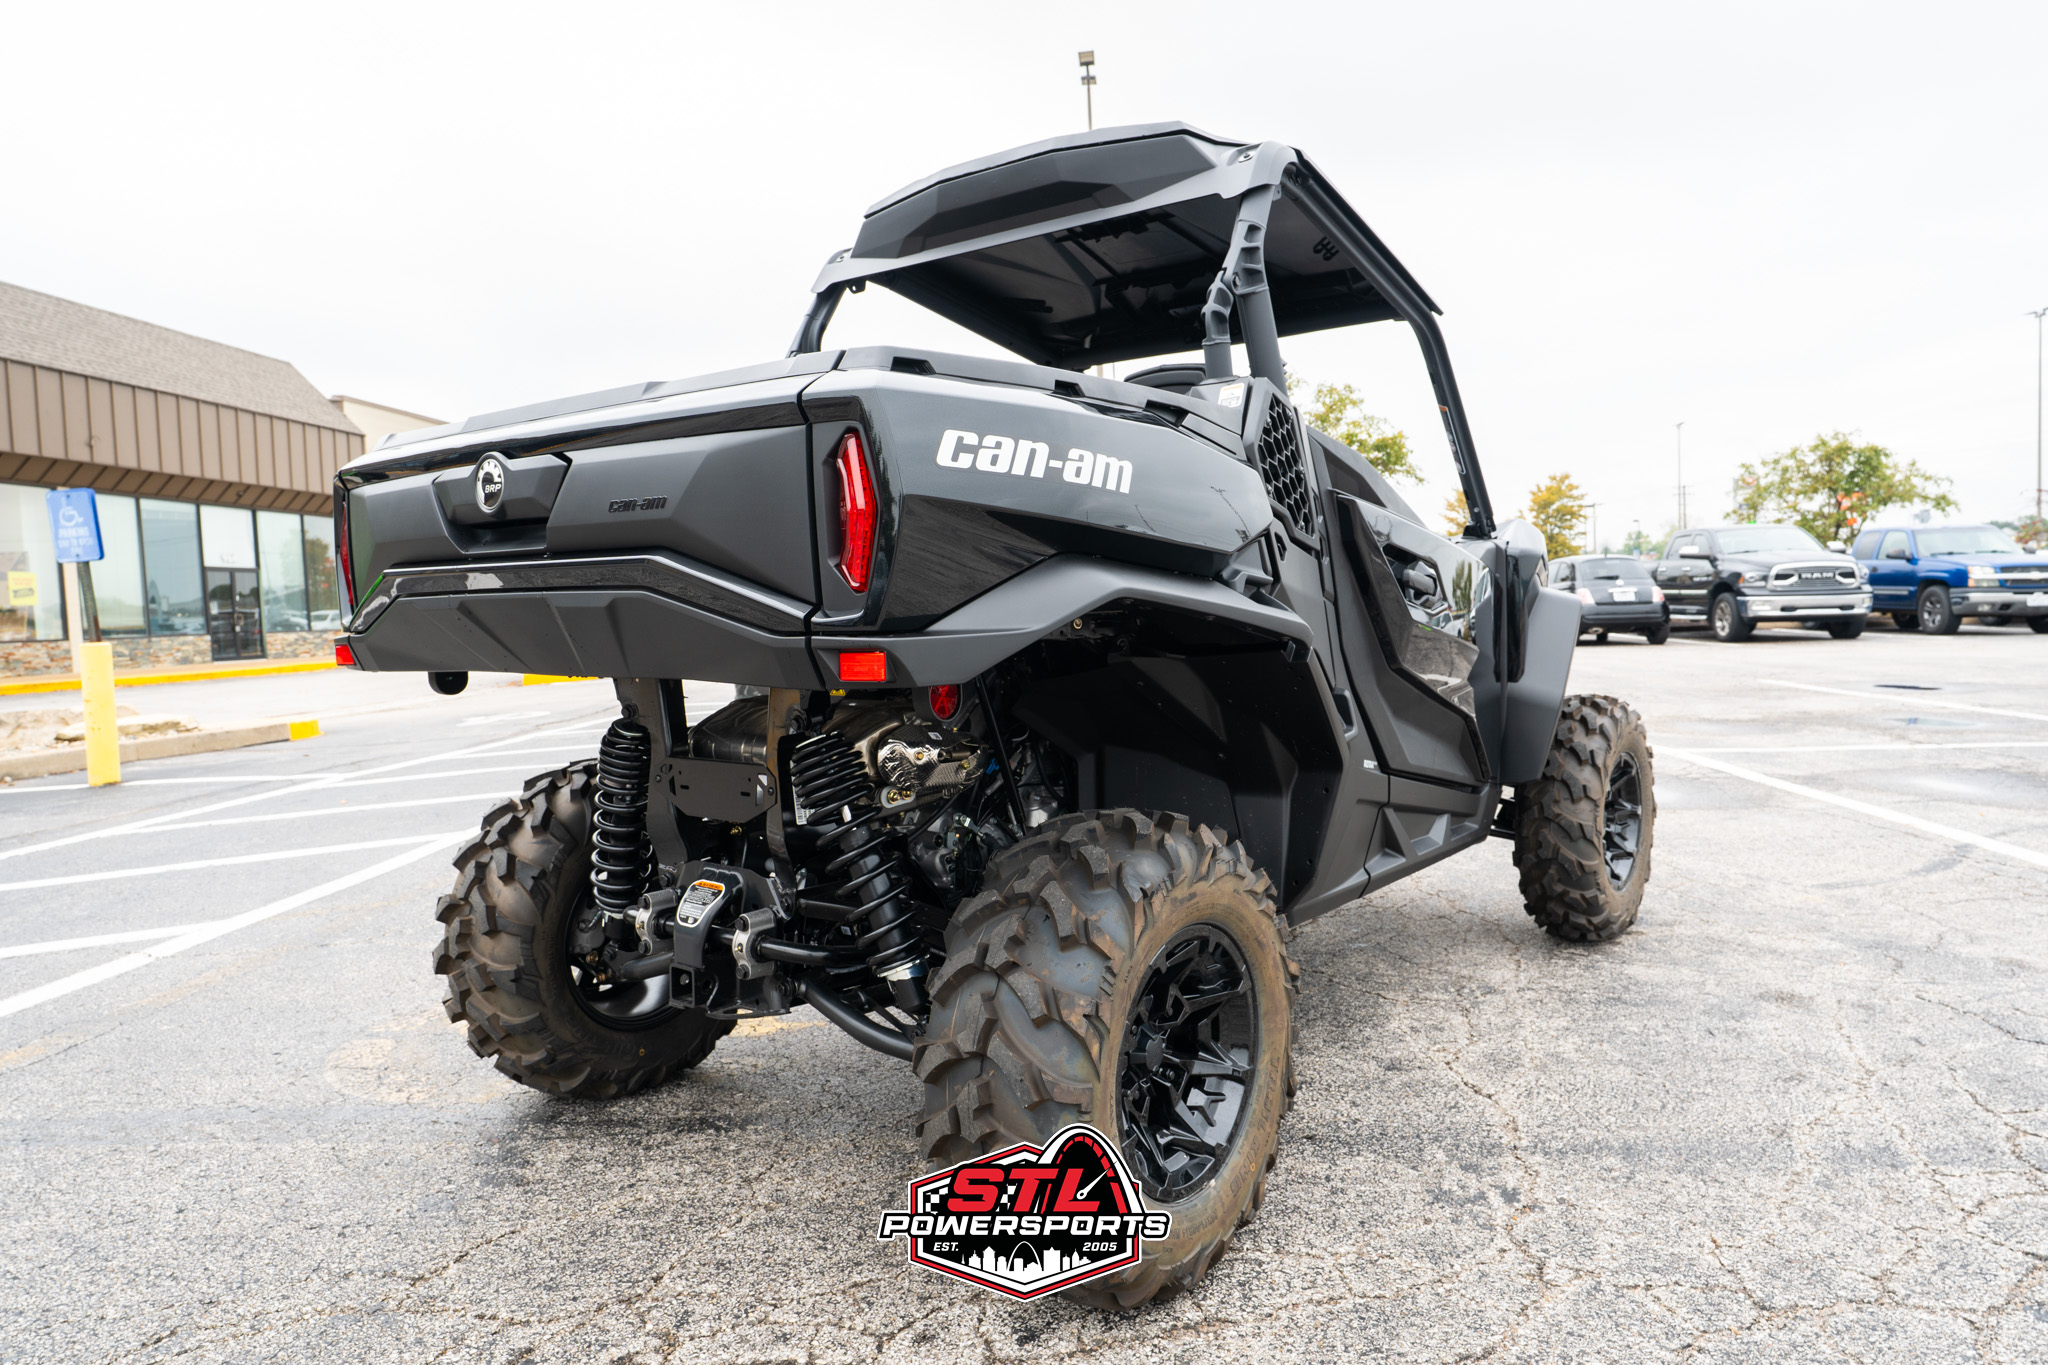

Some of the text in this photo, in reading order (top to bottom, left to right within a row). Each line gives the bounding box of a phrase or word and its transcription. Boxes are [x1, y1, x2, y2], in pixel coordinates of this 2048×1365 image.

[936, 429, 1133, 494] can-am
[484, 483, 502, 494] BRP
[607, 495, 668, 514] can-am
